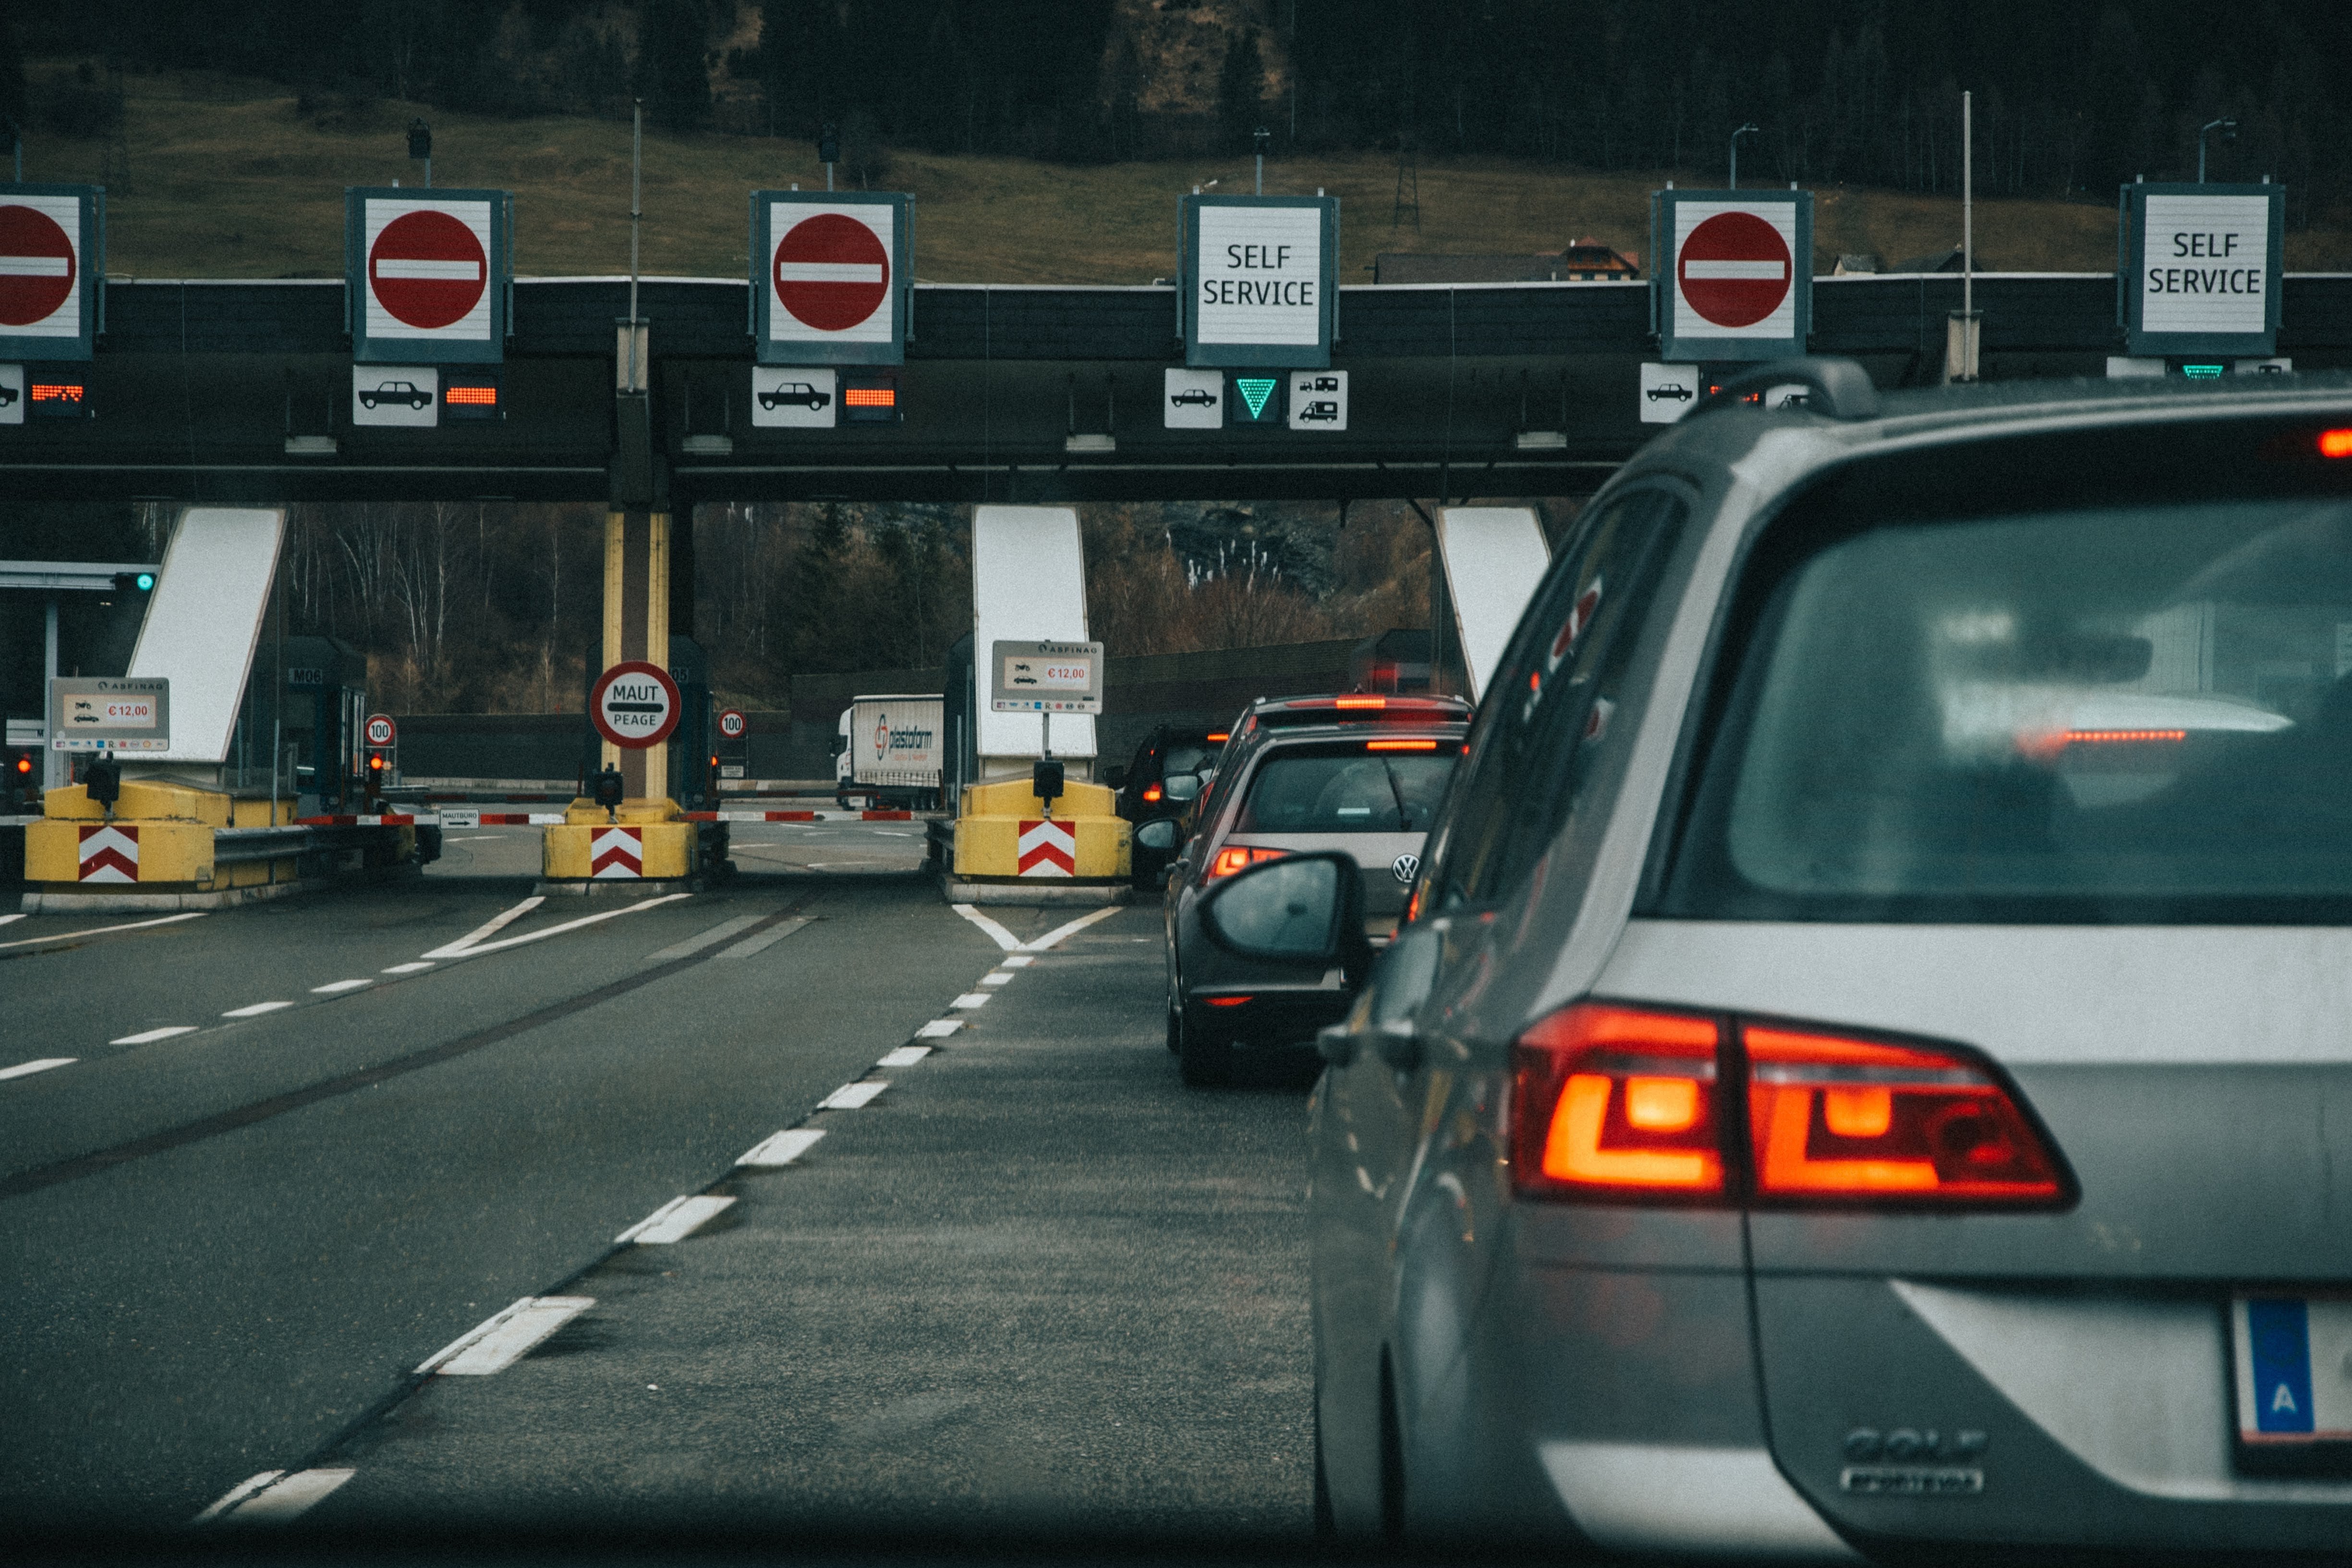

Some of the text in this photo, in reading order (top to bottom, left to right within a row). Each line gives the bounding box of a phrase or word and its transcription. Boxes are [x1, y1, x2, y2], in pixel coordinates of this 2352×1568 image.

[2174, 232, 2239, 257] SELF
[1227, 244, 1291, 268] SELF
[2149, 268, 2261, 293] SERVICE
[1203, 280, 1314, 305] SERVICE
[1058, 669, 1084, 679] 12,00
[613, 685, 658, 701] MAUT
[119, 705, 147, 717] 12,00
[614, 715, 656, 726] PEAGE
[371, 725, 389, 738] 100
[724, 717, 741, 730] 100
[889, 725, 932, 754] plastoform
[2272, 1383, 2297, 1413] A
